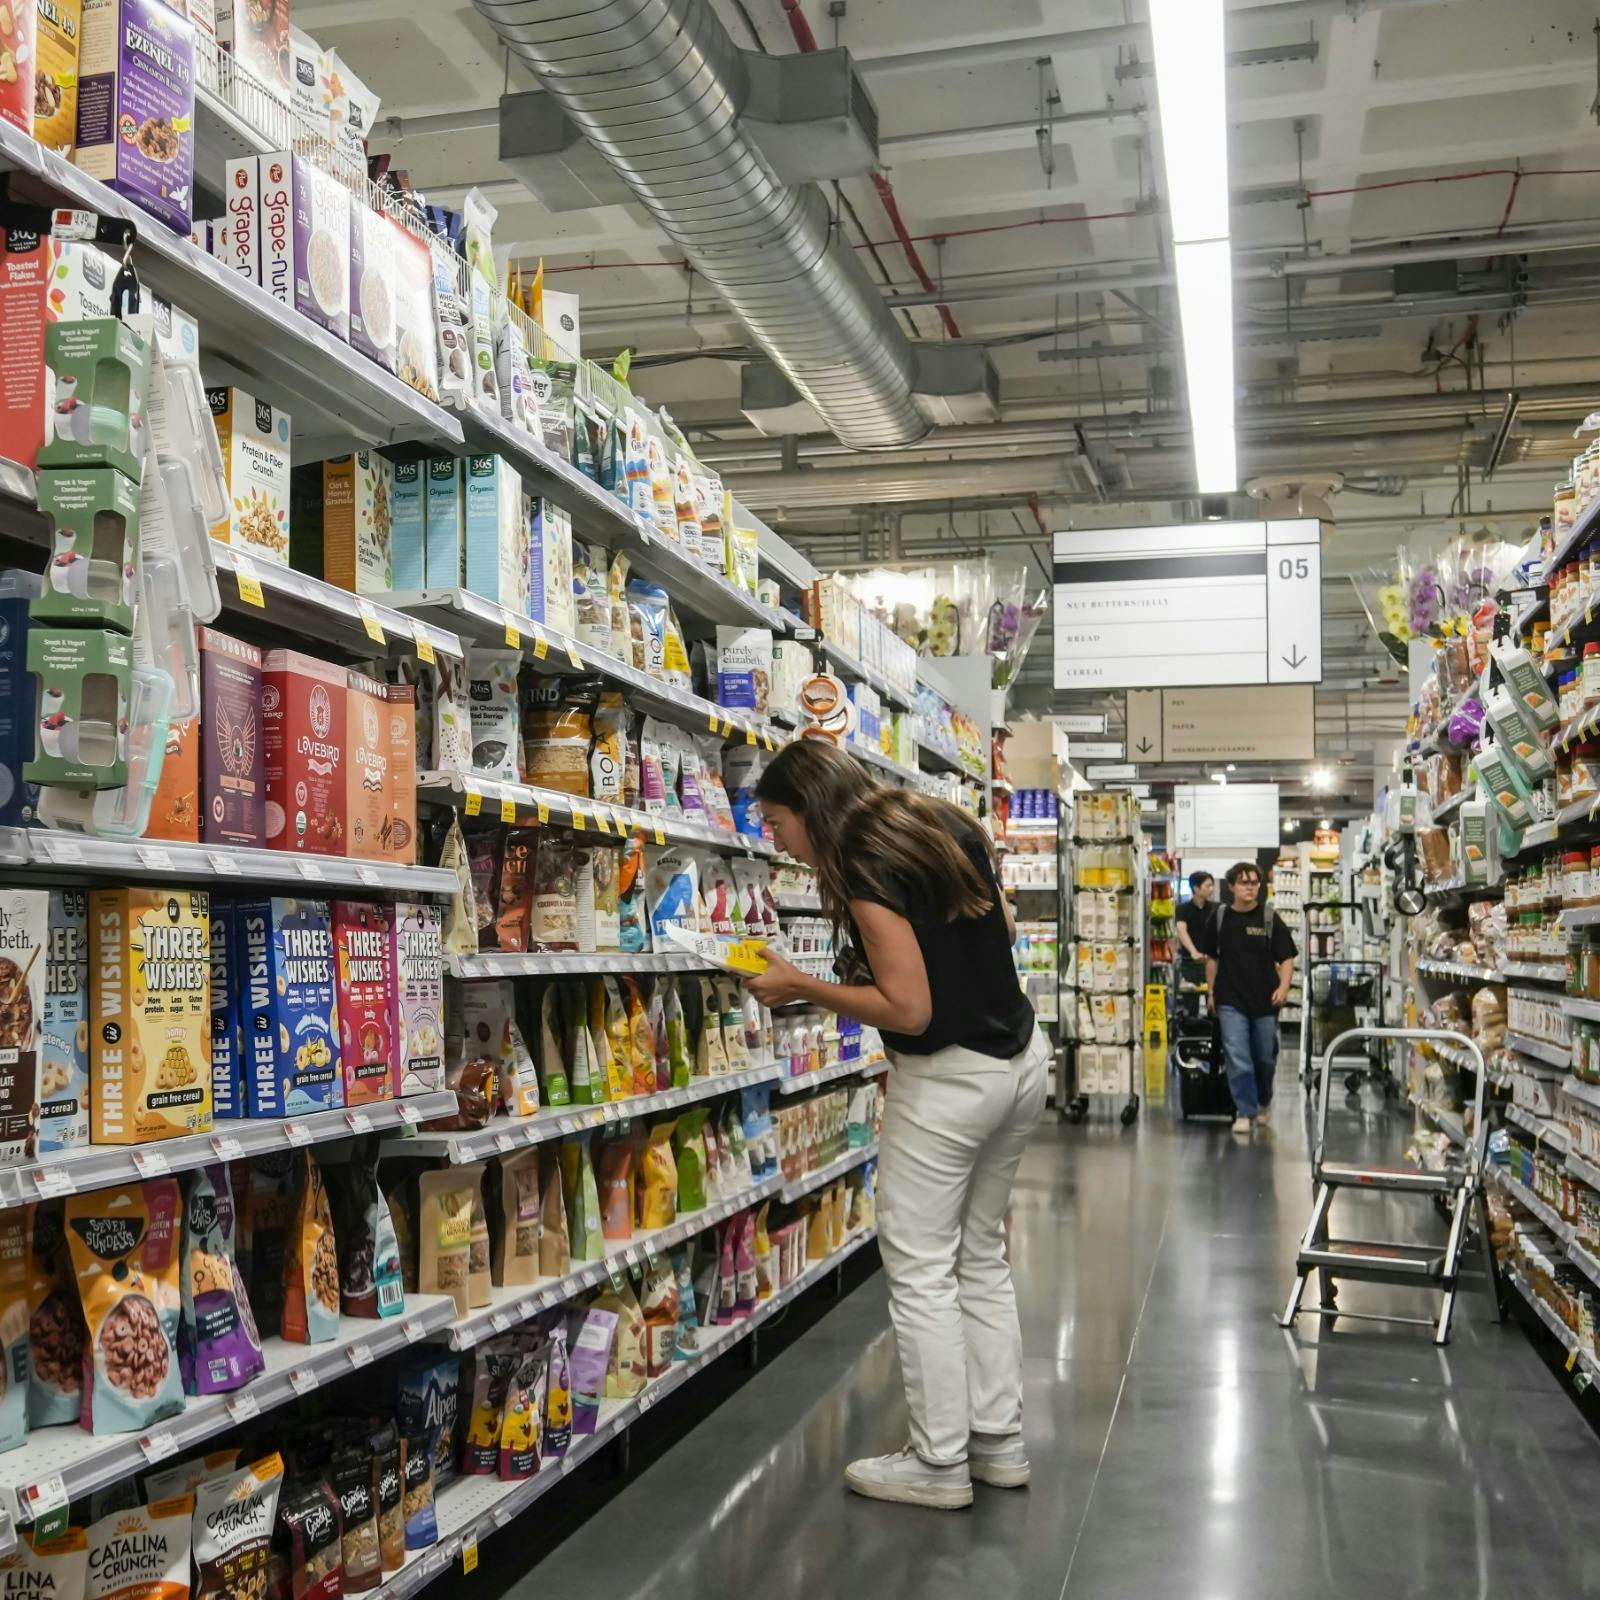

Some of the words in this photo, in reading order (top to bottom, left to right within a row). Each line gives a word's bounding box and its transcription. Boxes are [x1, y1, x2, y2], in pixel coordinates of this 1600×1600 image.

[229, 196, 255, 279] grape-n
[6, 259, 39, 272] Toasted
[9, 271, 36, 281] Flakes
[257, 404, 271, 425] 365
[242, 441, 264, 463] Protein
[270, 451, 284, 470] Fiber
[433, 461, 452, 473] 365
[472, 458, 492, 470] 365
[252, 460, 274, 479] Crunch
[397, 463, 416, 476] 365
[1279, 558, 1309, 580] 05
[1067, 601, 1086, 609] NUT
[649, 632, 664, 665] BOL
[722, 645, 753, 656] purely
[1067, 668, 1103, 677] CEREAL
[471, 684, 490, 694] 365
[530, 688, 560, 703] IND
[1178, 798, 1191, 809] 09
[0, 906, 12, 929] ly
[0, 929, 34, 949] beth.
[143, 926, 203, 960] THREE
[283, 929, 328, 958] THREE
[346, 931, 382, 958] THREE
[404, 931, 438, 957] THREE
[101, 911, 122, 1017] WISHES
[209, 919, 229, 1011] WISHES
[246, 916, 268, 1010] WISHES
[285, 960, 330, 984] WISHES
[348, 960, 384, 982] WISHES
[405, 959, 439, 982] WISHES
[45, 963, 78, 995] HES
[144, 962, 203, 990] WISHES
[147, 996, 162, 1005] More
[171, 996, 182, 1004] Less
[188, 995, 203, 1003] Gluten
[42, 1034, 72, 1056] etened
[212, 1036, 232, 1113] THREE
[254, 1035, 276, 1112] THREE
[296, 1073, 309, 1086] grain
[309, 1072, 320, 1082] free
[319, 1070, 333, 1081] cereal
[102, 1048, 124, 1137] THREE
[151, 1093, 169, 1107] grain
[169, 1092, 182, 1103] free
[183, 1090, 201, 1103] cereal
[40, 1107, 50, 1115] ee
[50, 1101, 74, 1114] cereal
[89, 1218, 126, 1233] SEVEN
[85, 1228, 135, 1255] SUNDAYS
[425, 1389, 457, 1430] Alpen
[206, 1493, 266, 1530] CATALINA
[217, 1510, 259, 1540] CRUNCH
[88, 1535, 168, 1570] CATALINA
[102, 1553, 157, 1580] CRUNCH
